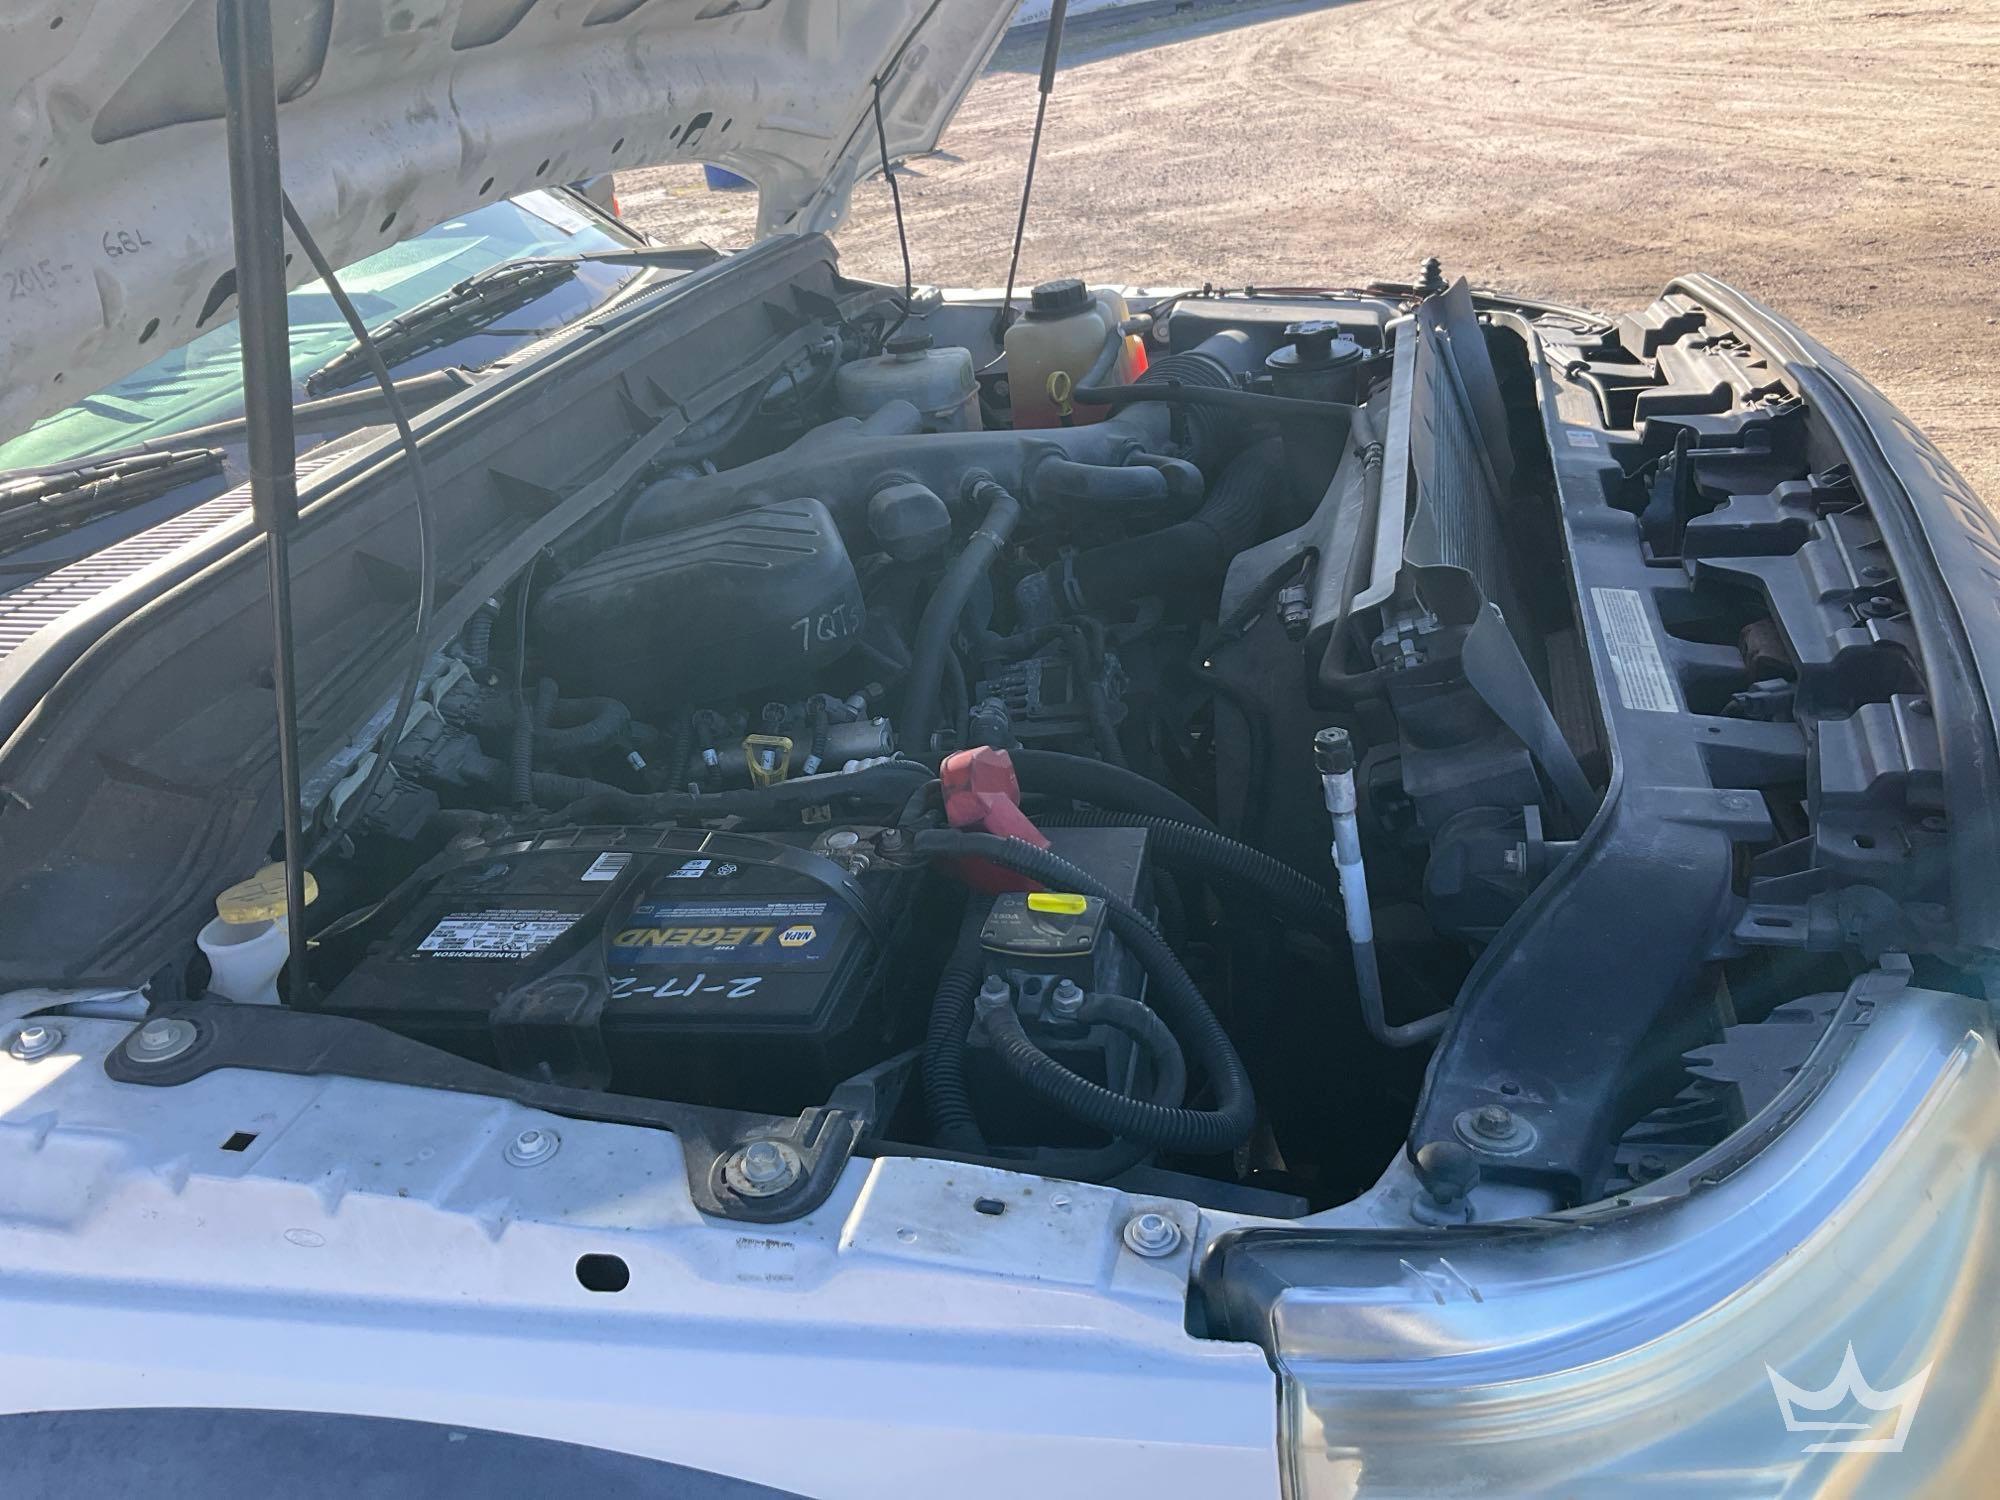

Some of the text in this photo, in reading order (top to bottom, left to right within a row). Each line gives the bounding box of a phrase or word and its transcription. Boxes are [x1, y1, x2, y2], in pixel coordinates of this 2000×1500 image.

[613, 927, 777, 946] LEGEND
[784, 930, 812, 941] NAPA
[432, 951, 521, 959] DANGER/POISON
